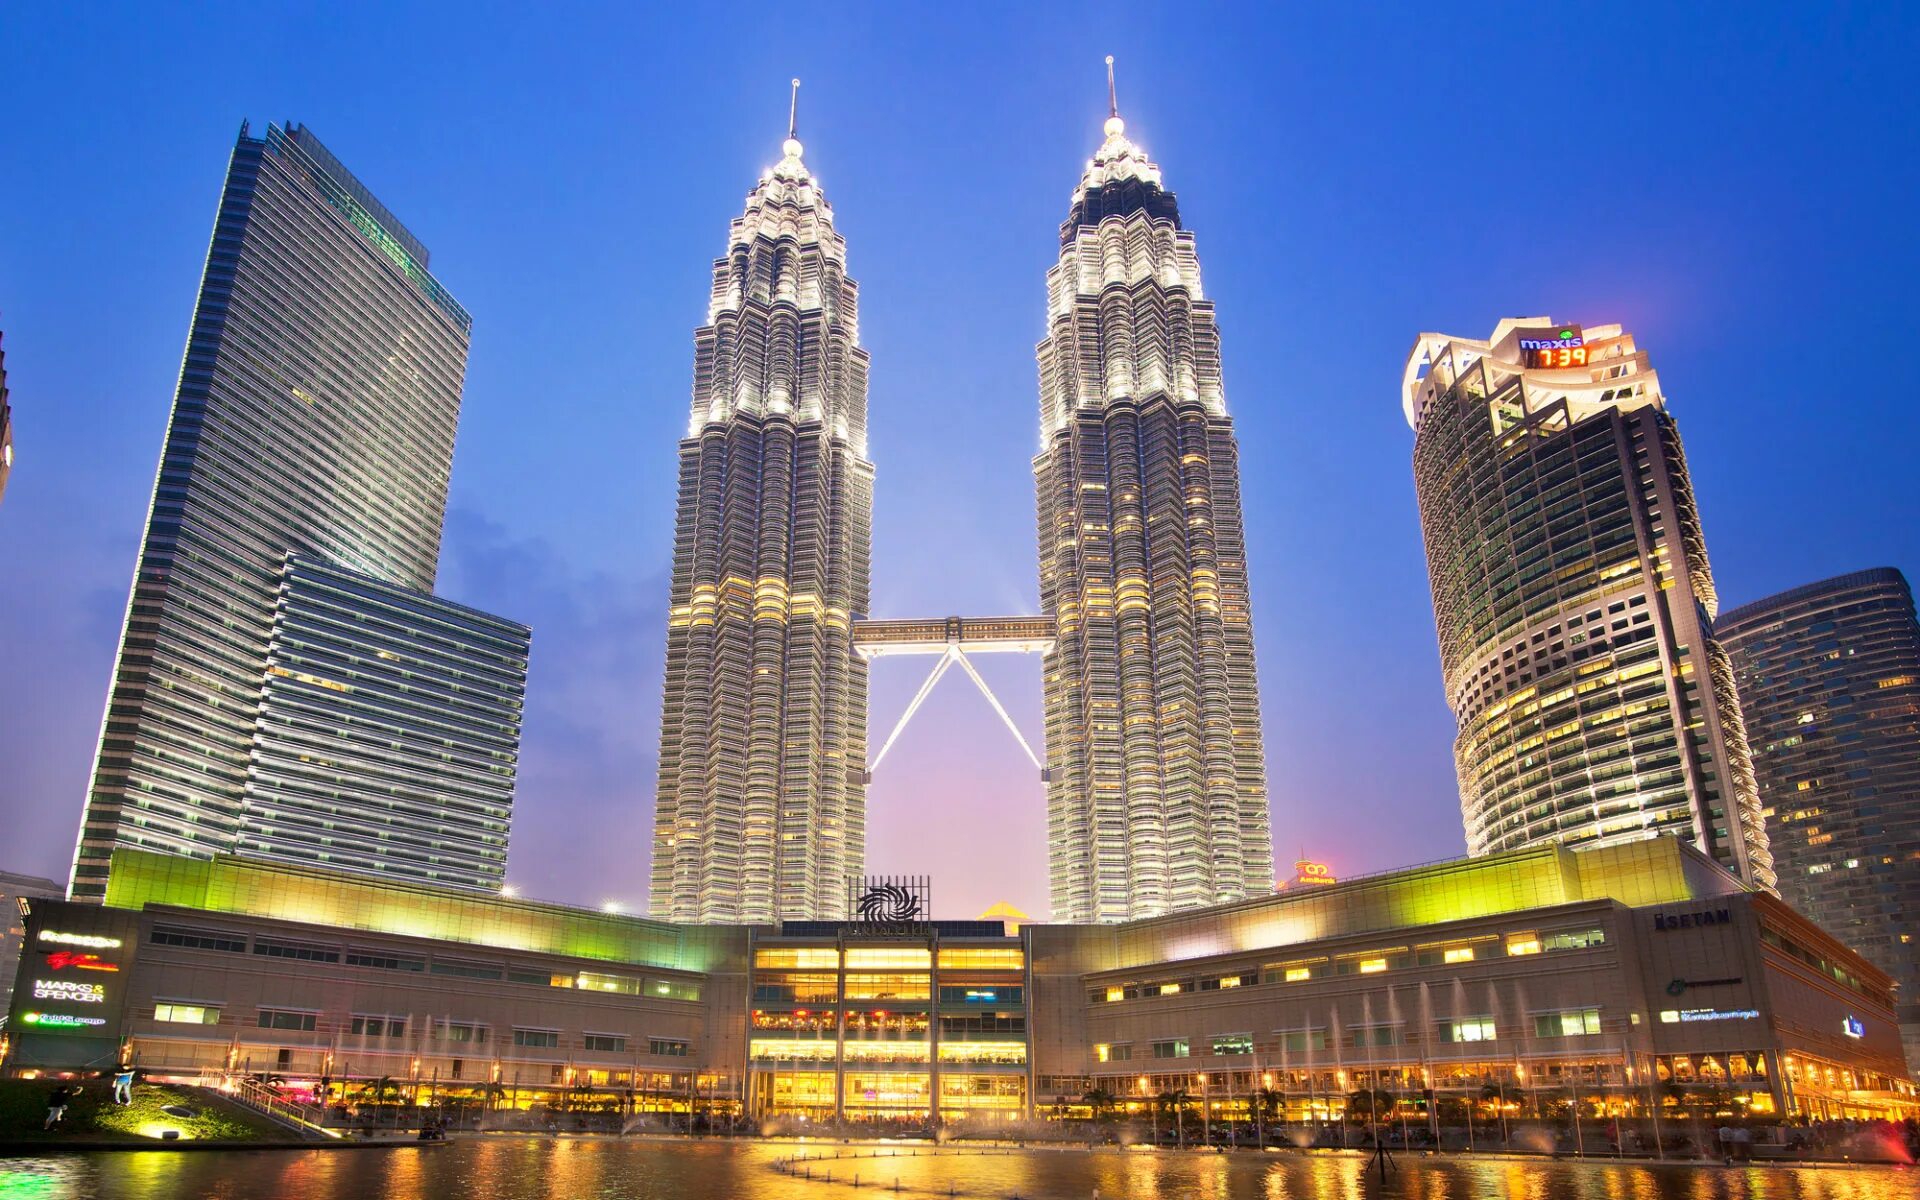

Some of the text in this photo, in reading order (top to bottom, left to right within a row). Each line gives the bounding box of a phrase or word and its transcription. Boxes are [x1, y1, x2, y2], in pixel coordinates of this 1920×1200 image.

[1520, 336, 1582, 350] maxis
[1540, 348, 1586, 367] 7:39
[1654, 909, 1730, 929] ISETAN
[35, 980, 104, 994] MARKS &
[34, 989, 104, 1003] SPENCER
